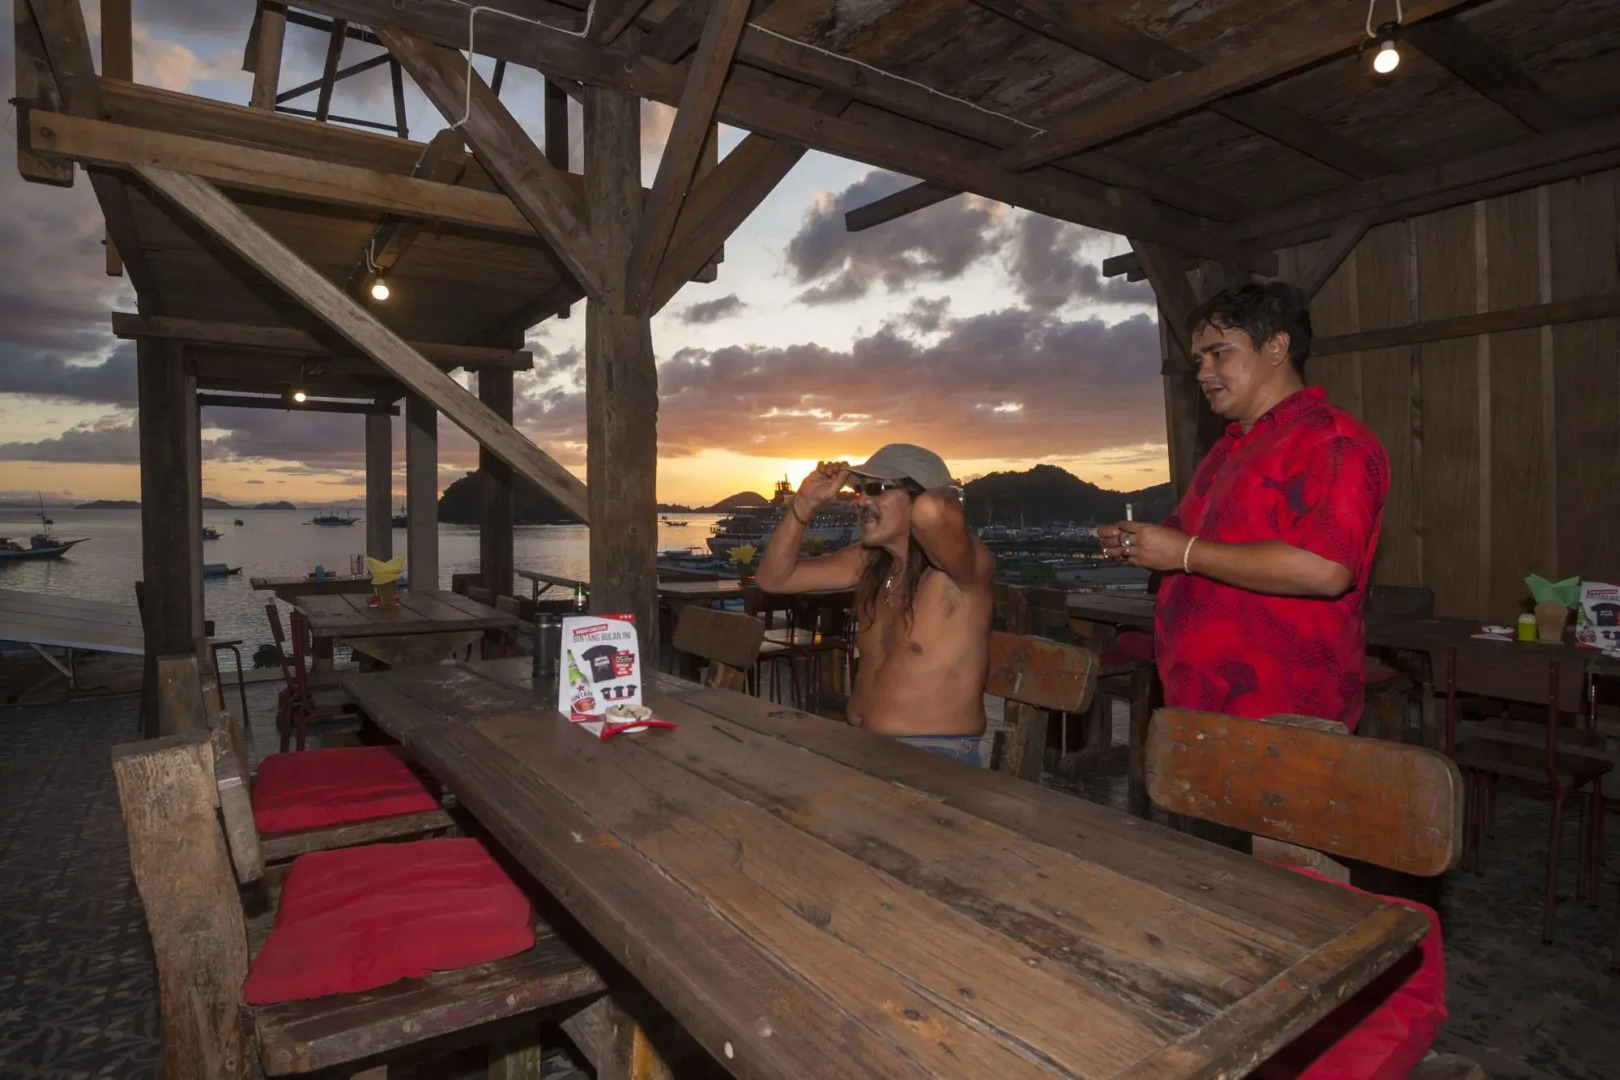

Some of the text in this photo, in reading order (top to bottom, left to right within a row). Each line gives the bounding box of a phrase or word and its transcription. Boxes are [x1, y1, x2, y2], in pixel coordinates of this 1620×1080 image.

[573, 631, 631, 643] BINTANG BULAN INI
